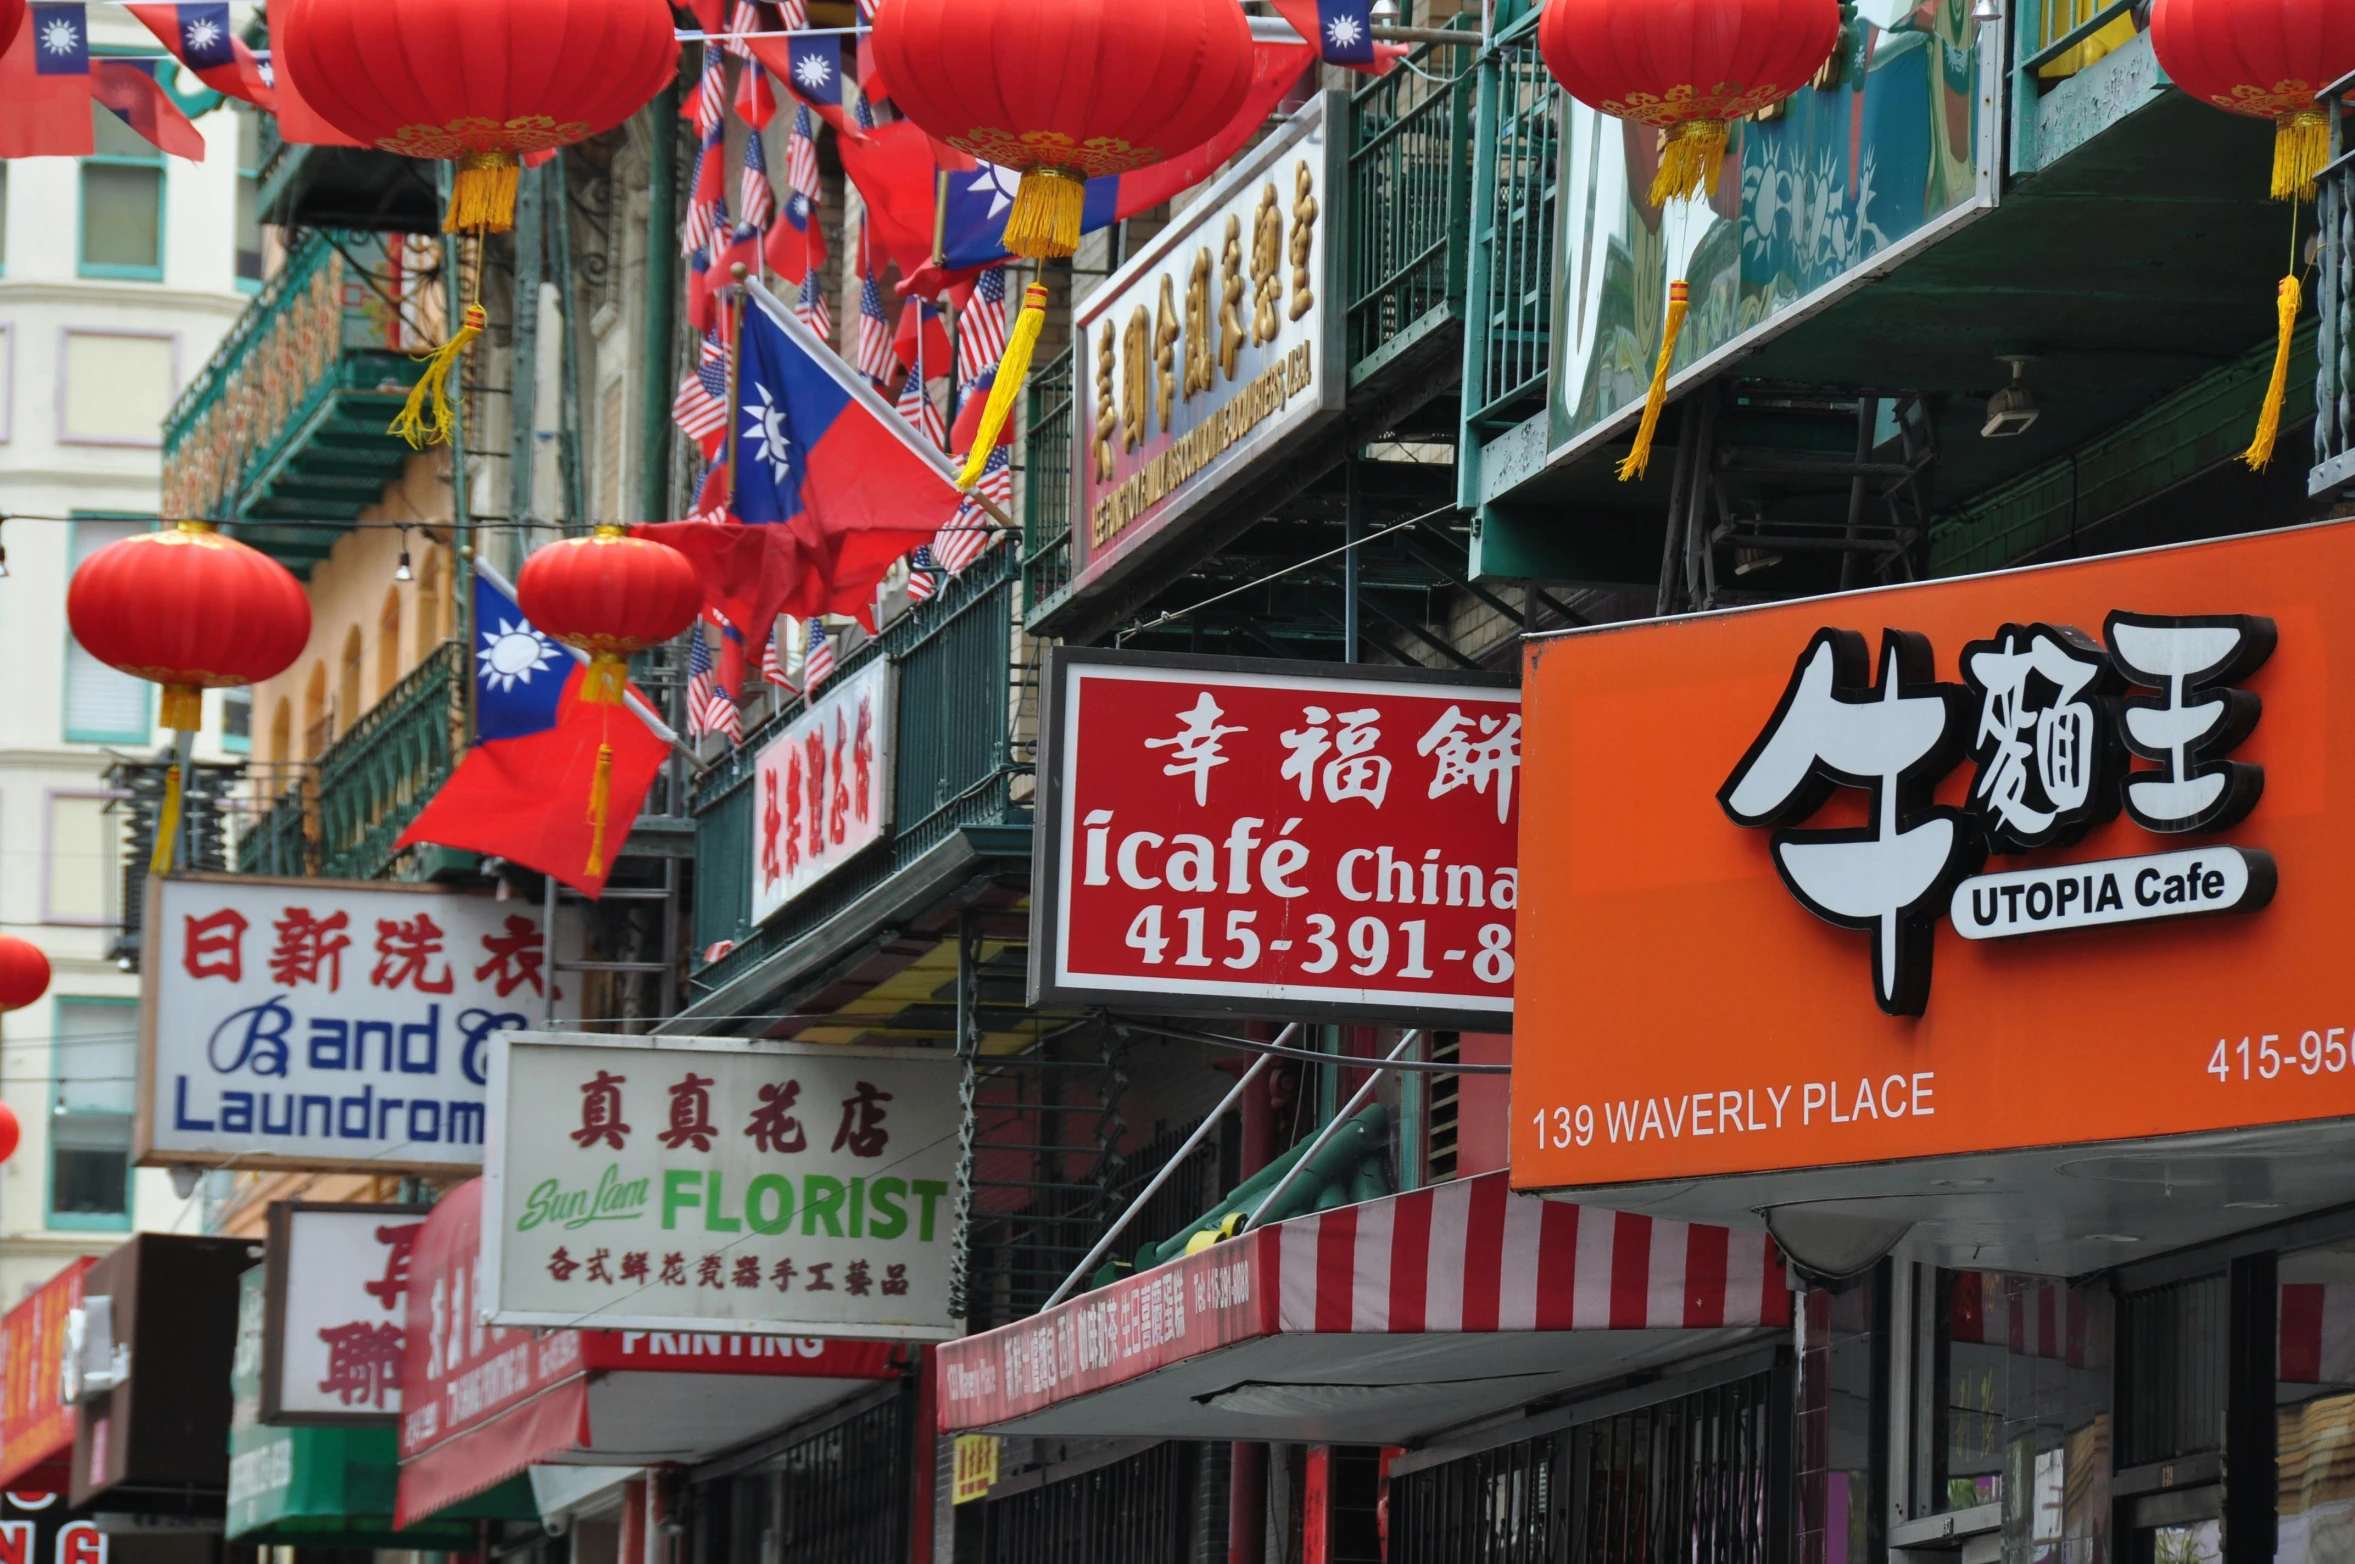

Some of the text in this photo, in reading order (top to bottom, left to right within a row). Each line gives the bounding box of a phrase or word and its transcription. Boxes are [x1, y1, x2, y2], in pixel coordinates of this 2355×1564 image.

[1144, 690, 1521, 825] 幸福餅
[1336, 845, 1519, 909] China
[1972, 861, 2225, 926] UTOPIA Cafe
[182, 906, 563, 1001] 日新洗衣
[1124, 904, 1514, 984] 415-391-8
[308, 1003, 440, 1074] and
[2207, 1027, 2355, 1083] 415-95
[173, 1074, 486, 1145] Laundrom
[570, 1069, 893, 1158] 真真花店
[1532, 1071, 1935, 1150] 139 WAVERLY PLACE
[516, 1162, 948, 1243] Sun Lam FLORIST
